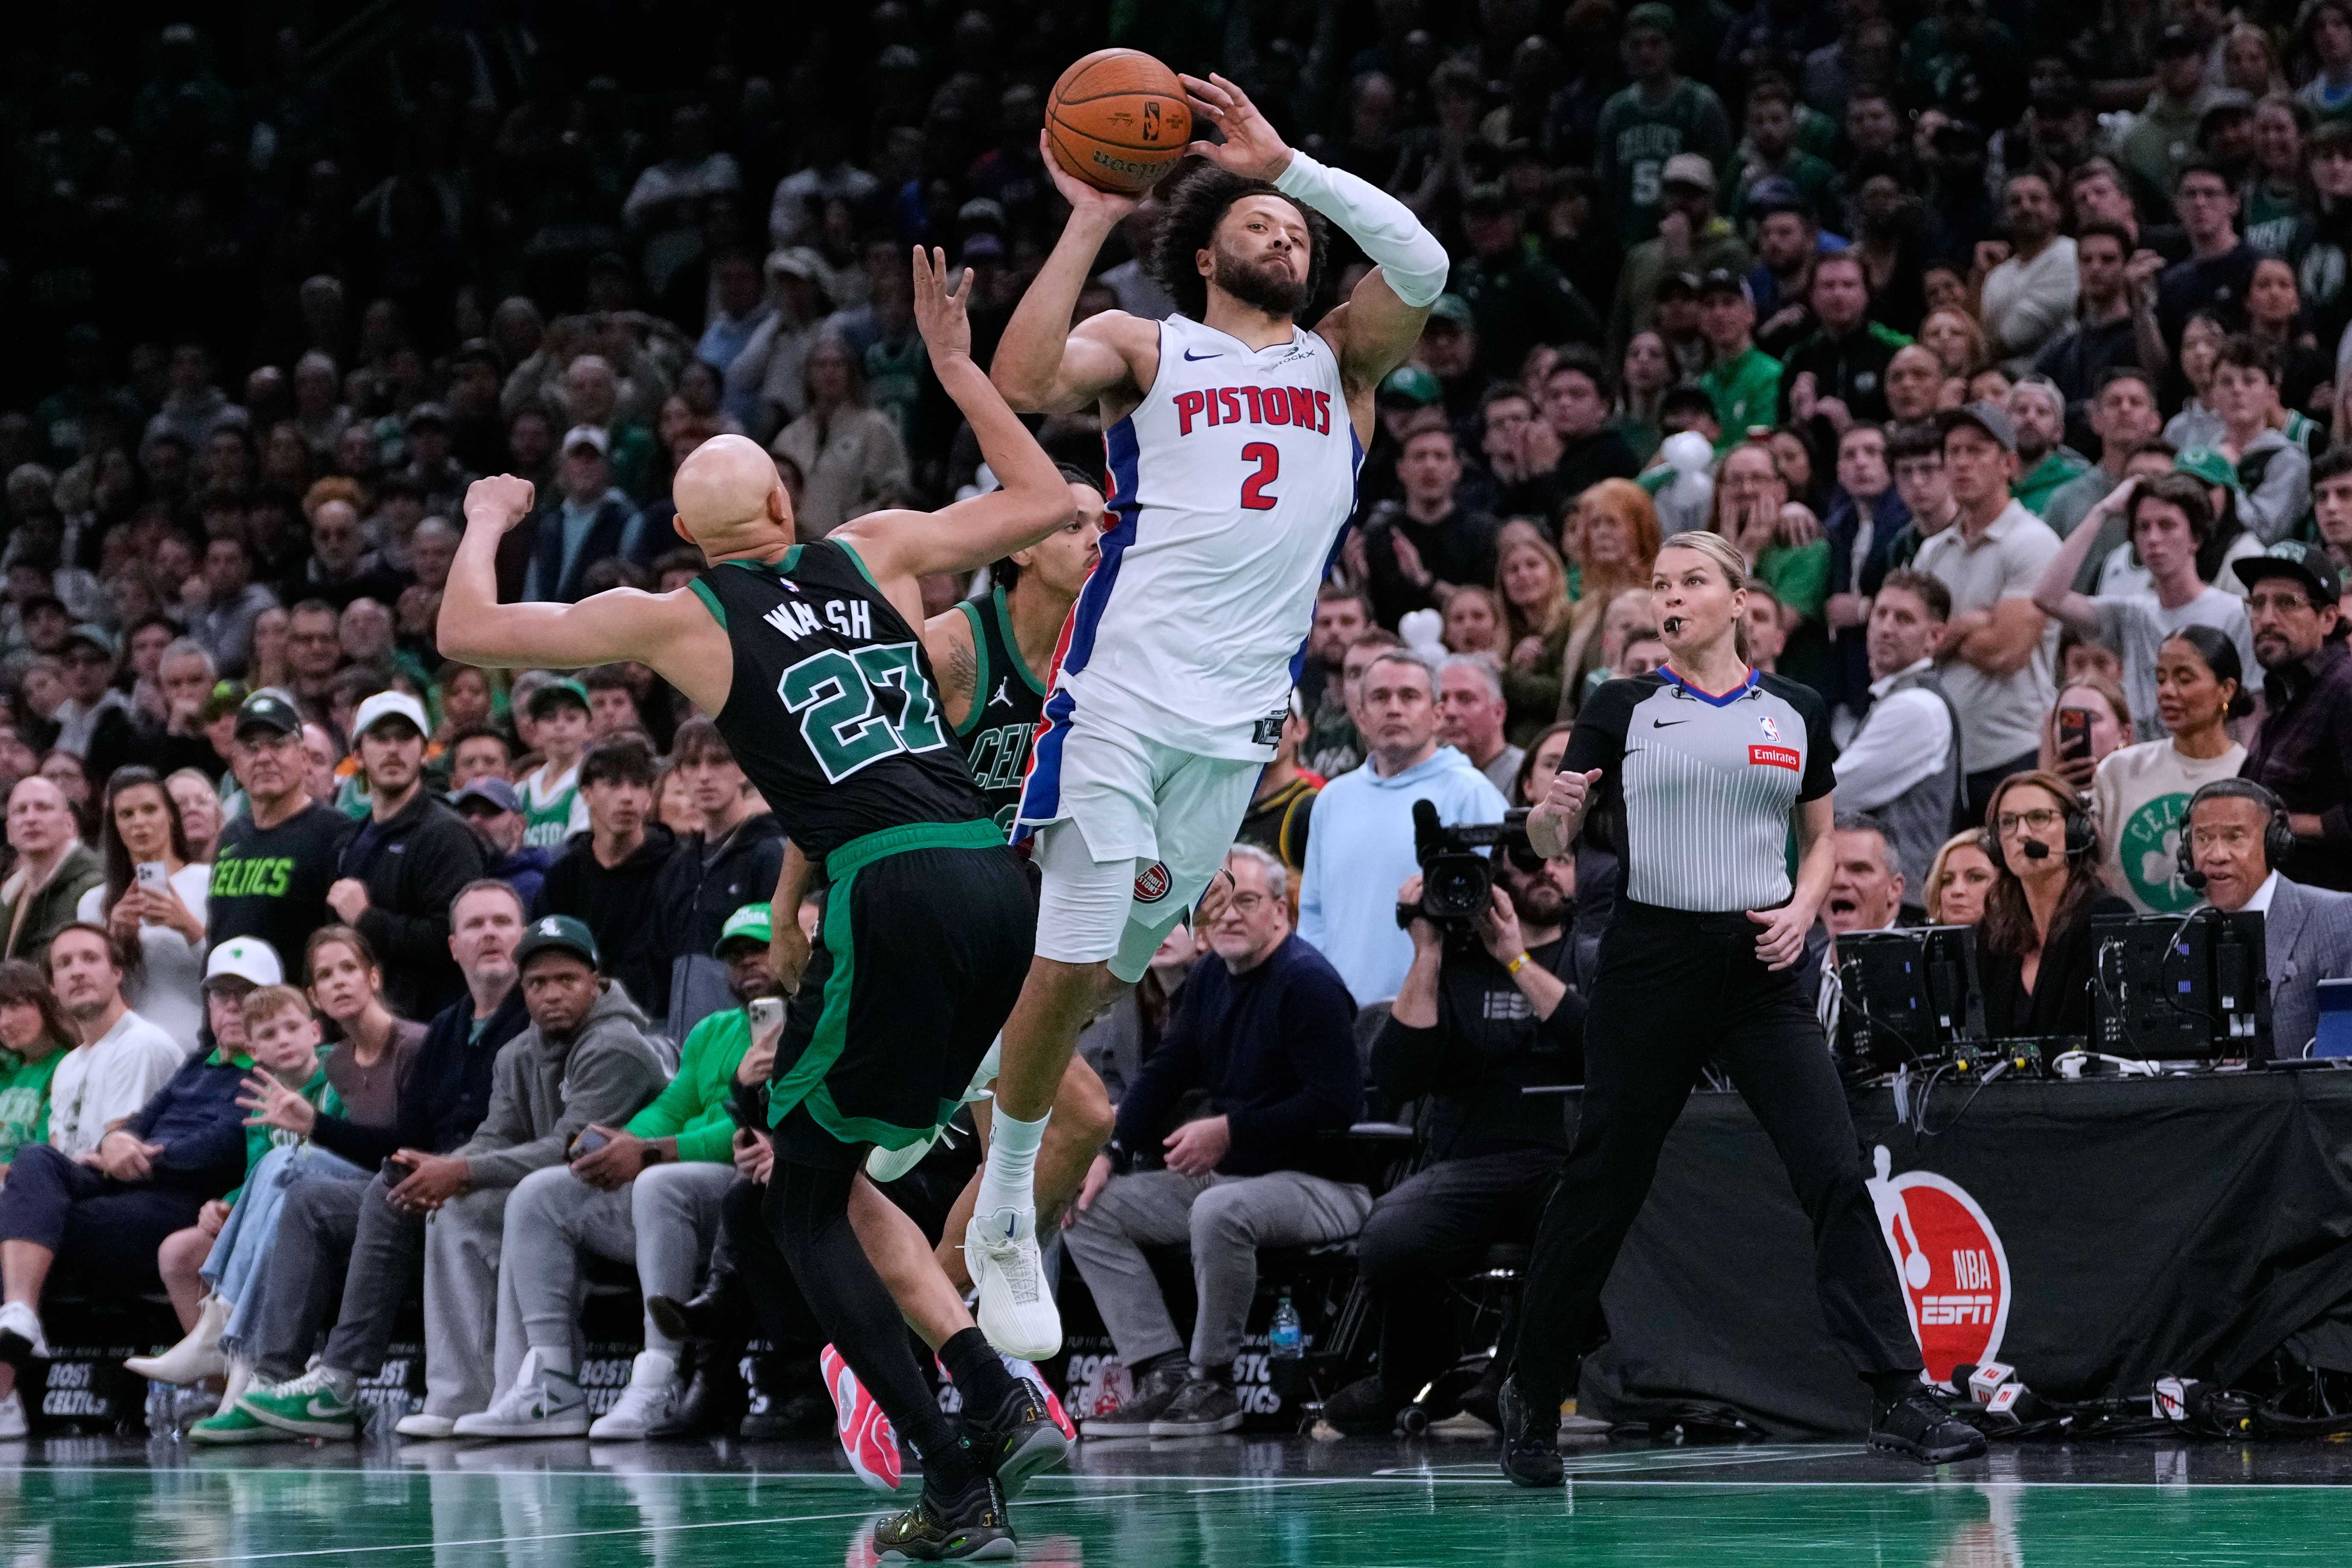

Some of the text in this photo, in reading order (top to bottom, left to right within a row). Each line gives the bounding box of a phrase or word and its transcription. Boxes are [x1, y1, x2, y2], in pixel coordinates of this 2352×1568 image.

[1173, 386, 1330, 437] PISTONS
[1240, 442, 1279, 510] 2
[763, 599, 871, 642] WASH
[777, 641, 948, 785] 27
[1754, 749, 1797, 765] Emirates
[1952, 1249, 1992, 1290] NBA
[1921, 1295, 1993, 1324] ESPN
